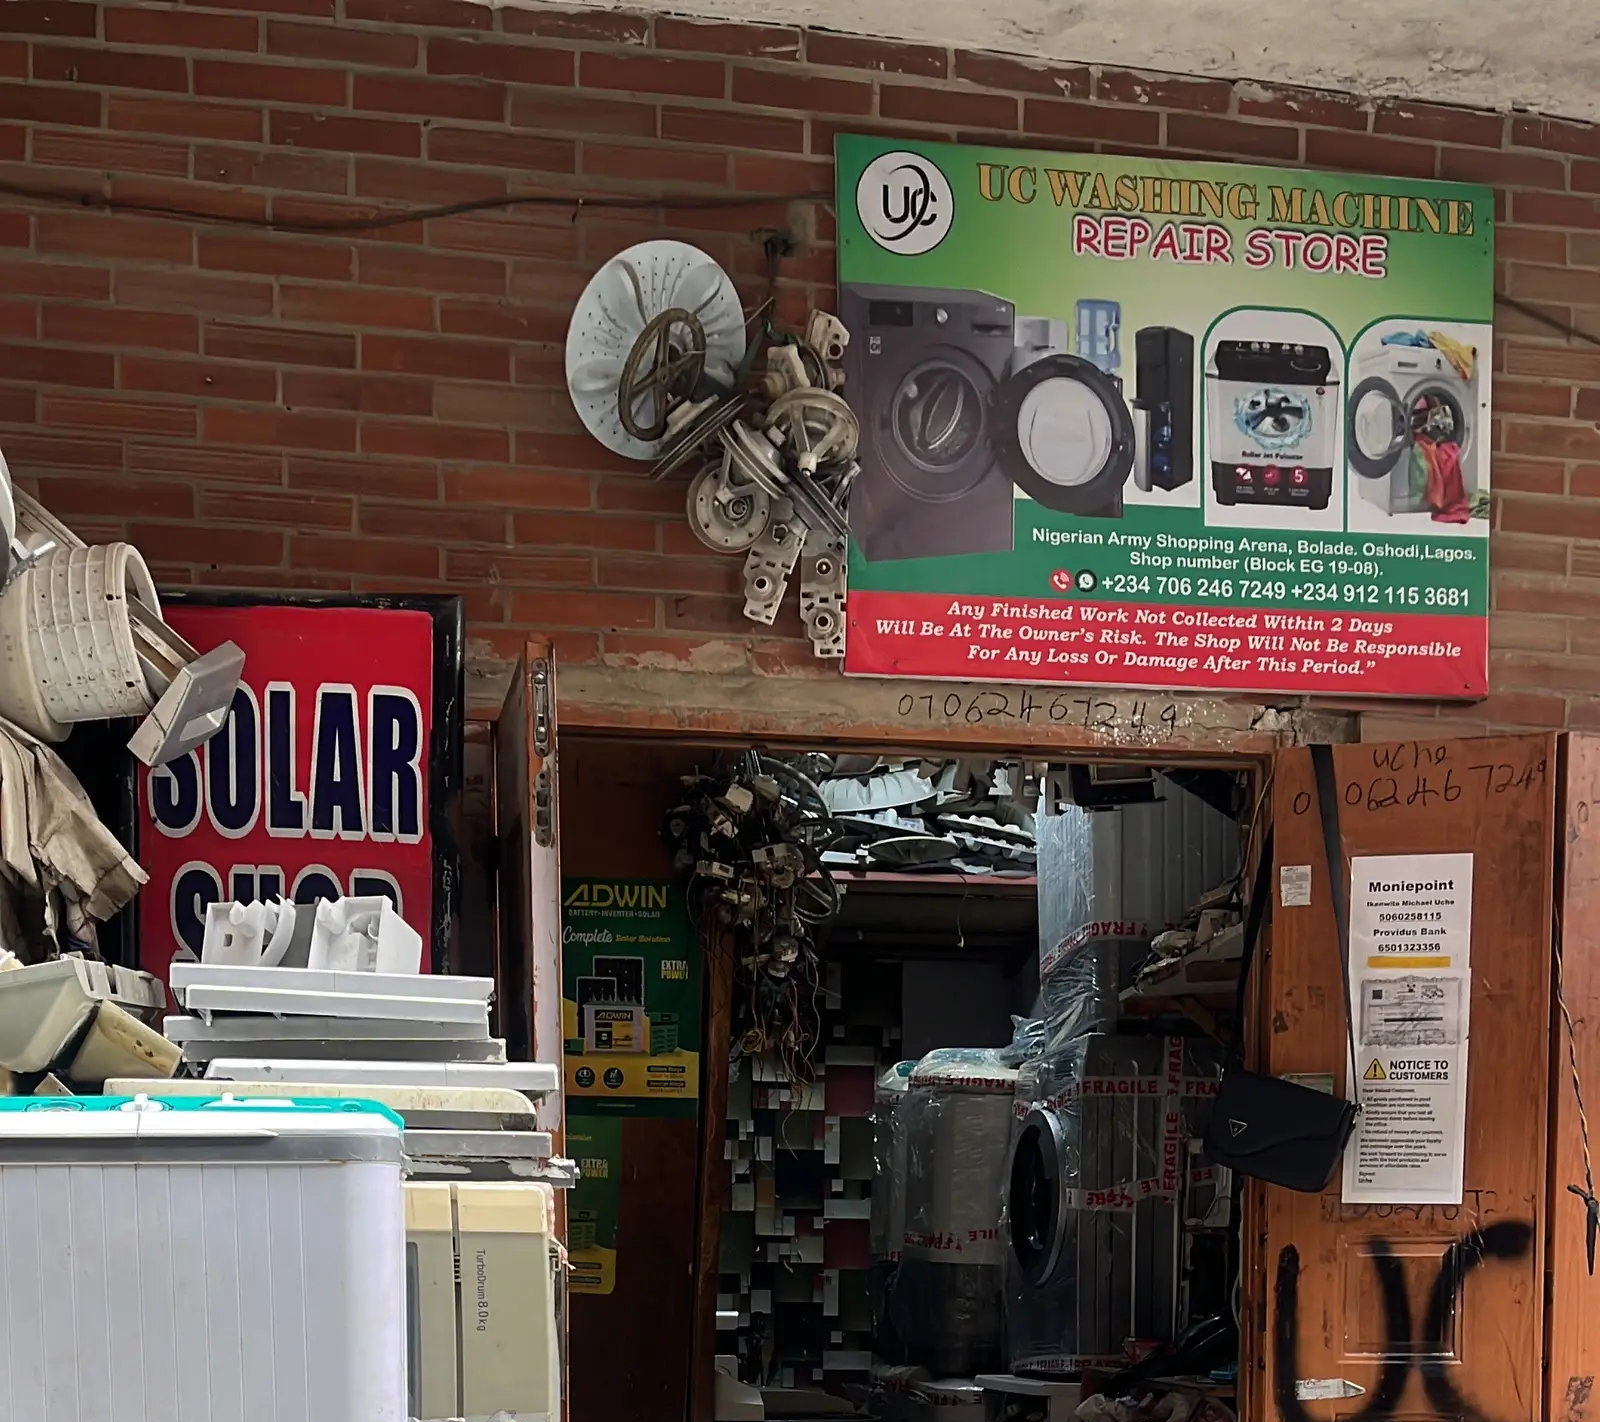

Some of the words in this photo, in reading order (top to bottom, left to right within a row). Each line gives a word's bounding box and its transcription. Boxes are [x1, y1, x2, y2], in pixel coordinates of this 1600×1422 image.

[882, 184, 937, 226] UC
[976, 162, 1037, 204] UC
[1044, 168, 1260, 221] WASHING
[1267, 185, 1475, 237] MACHINE
[1074, 214, 1233, 265] REPAIR
[1245, 229, 1388, 279] STORE
[1294, 469, 1304, 483] 5
[1032, 527, 1103, 546] Nigerian
[1107, 531, 1152, 549] Army
[1156, 534, 1234, 554] Shopping
[1238, 537, 1293, 555] Arena,
[1297, 540, 1358, 556] Bolade.
[1130, 551, 1172, 569] Shop
[1176, 555, 1240, 570] number
[1244, 557, 1296, 574] (Block
[1300, 559, 1324, 574] EG
[1328, 561, 1384, 578] 19-08).
[1102, 574, 1150, 594] +234
[1156, 576, 1192, 596] 706
[1196, 578, 1233, 598] 246
[1239, 580, 1286, 600] 7249
[1290, 583, 1338, 602] +234
[1343, 584, 1379, 604] 912
[1384, 586, 1419, 605] 115
[1424, 587, 1469, 607] 3681
[947, 601, 985, 620] Any
[991, 602, 1073, 621] Finished
[1079, 606, 1129, 623] Work
[1134, 608, 1166, 625] Not
[1171, 611, 1258, 629] Collected
[1263, 614, 1325, 632] Within
[1330, 617, 1343, 632] 2
[1348, 618, 1393, 637] Days
[876, 619, 915, 636] Will
[919, 621, 944, 637] Be
[948, 622, 971, 638] At
[978, 623, 1013, 640] The
[1018, 625, 1094, 643] Owner’s
[1099, 628, 1147, 645] Risk.
[1155, 631, 1189, 648] The
[1194, 633, 1241, 652] Shop
[1247, 635, 1284, 652] Will
[1289, 638, 1321, 653] Not
[1325, 638, 1349, 654] Be
[1353, 640, 1462, 659] Responsible
[967, 644, 1001, 660] For
[1004, 646, 1042, 665] Any
[1046, 648, 1089, 665] Loss
[1094, 650, 1118, 665] Or
[1123, 651, 1198, 672] Damage
[1202, 655, 1251, 673] After
[1256, 657, 1297, 674] This
[146, 681, 423, 844] SOLAR
[563, 883, 667, 908] ADWIN
[1368, 879, 1455, 893] Moniepoint
[1378, 912, 1442, 921] 5060258115
[562, 925, 613, 948] Complete
[1373, 928, 1417, 937] Providus
[1420, 927, 1447, 936] Bank
[1389, 1060, 1431, 1070] NOTICE
[1433, 1060, 1449, 1070] TO
[1389, 1071, 1449, 1081] CUSTOMERS
[1080, 1080, 1159, 1095] FRAGILE
[1162, 1112, 1179, 1191] FRAGILE
[476, 1248, 487, 1300] TurboDrum
